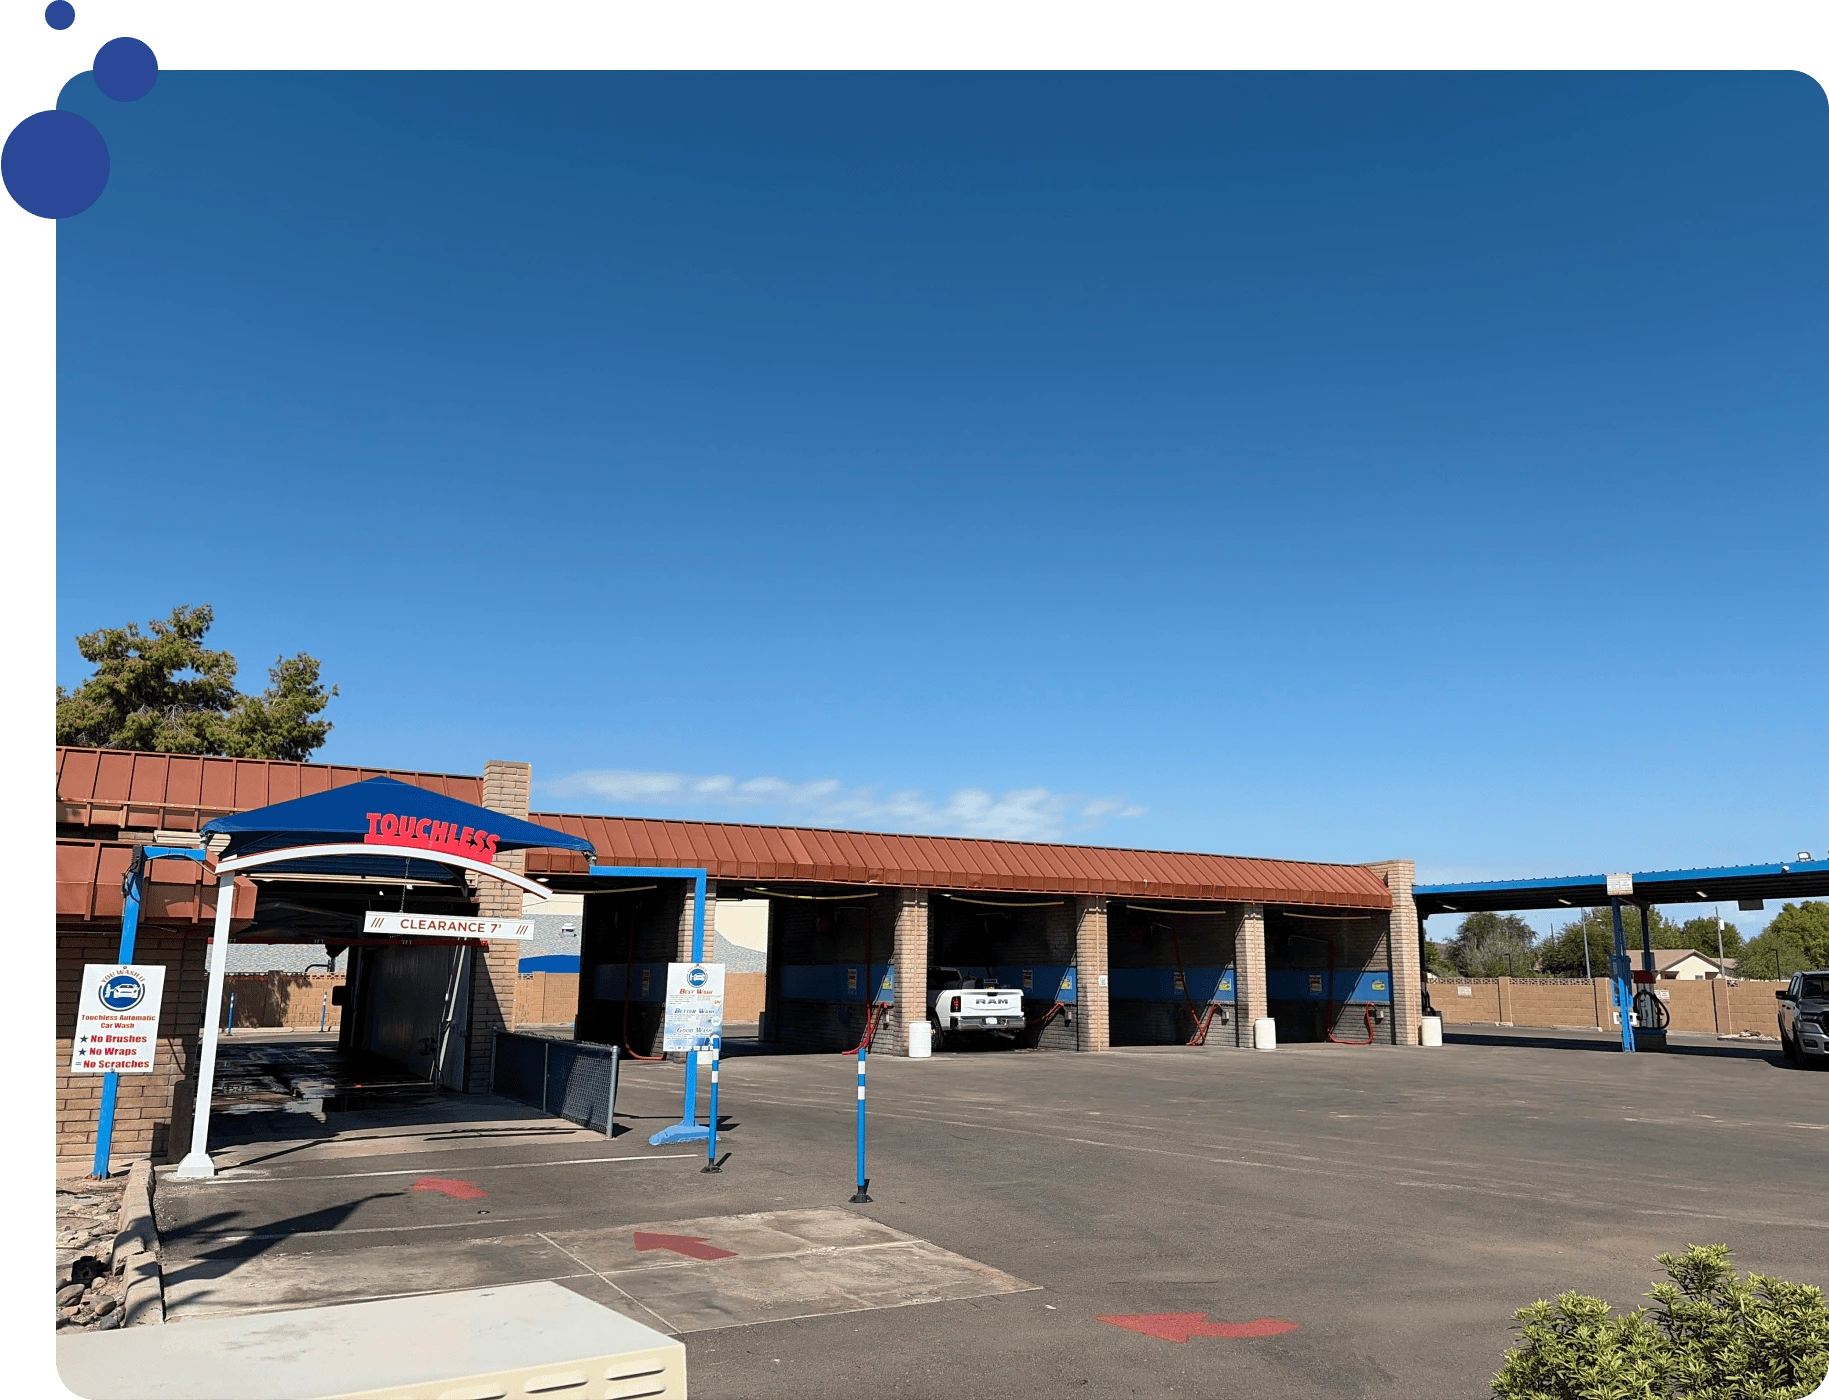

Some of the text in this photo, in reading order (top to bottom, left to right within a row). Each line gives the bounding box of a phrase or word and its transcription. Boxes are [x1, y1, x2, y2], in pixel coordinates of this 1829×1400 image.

[365, 812, 500, 860] TOUCHLESS
[400, 918, 486, 933] CLEARANCE
[101, 972, 116, 983] YOU
[116, 969, 140, 979] WASH
[90, 1034, 148, 1043] No Brushes
[89, 1047, 137, 1057] No Wraps
[83, 1060, 96, 1069] No
[98, 1060, 150, 1069] Scratches
